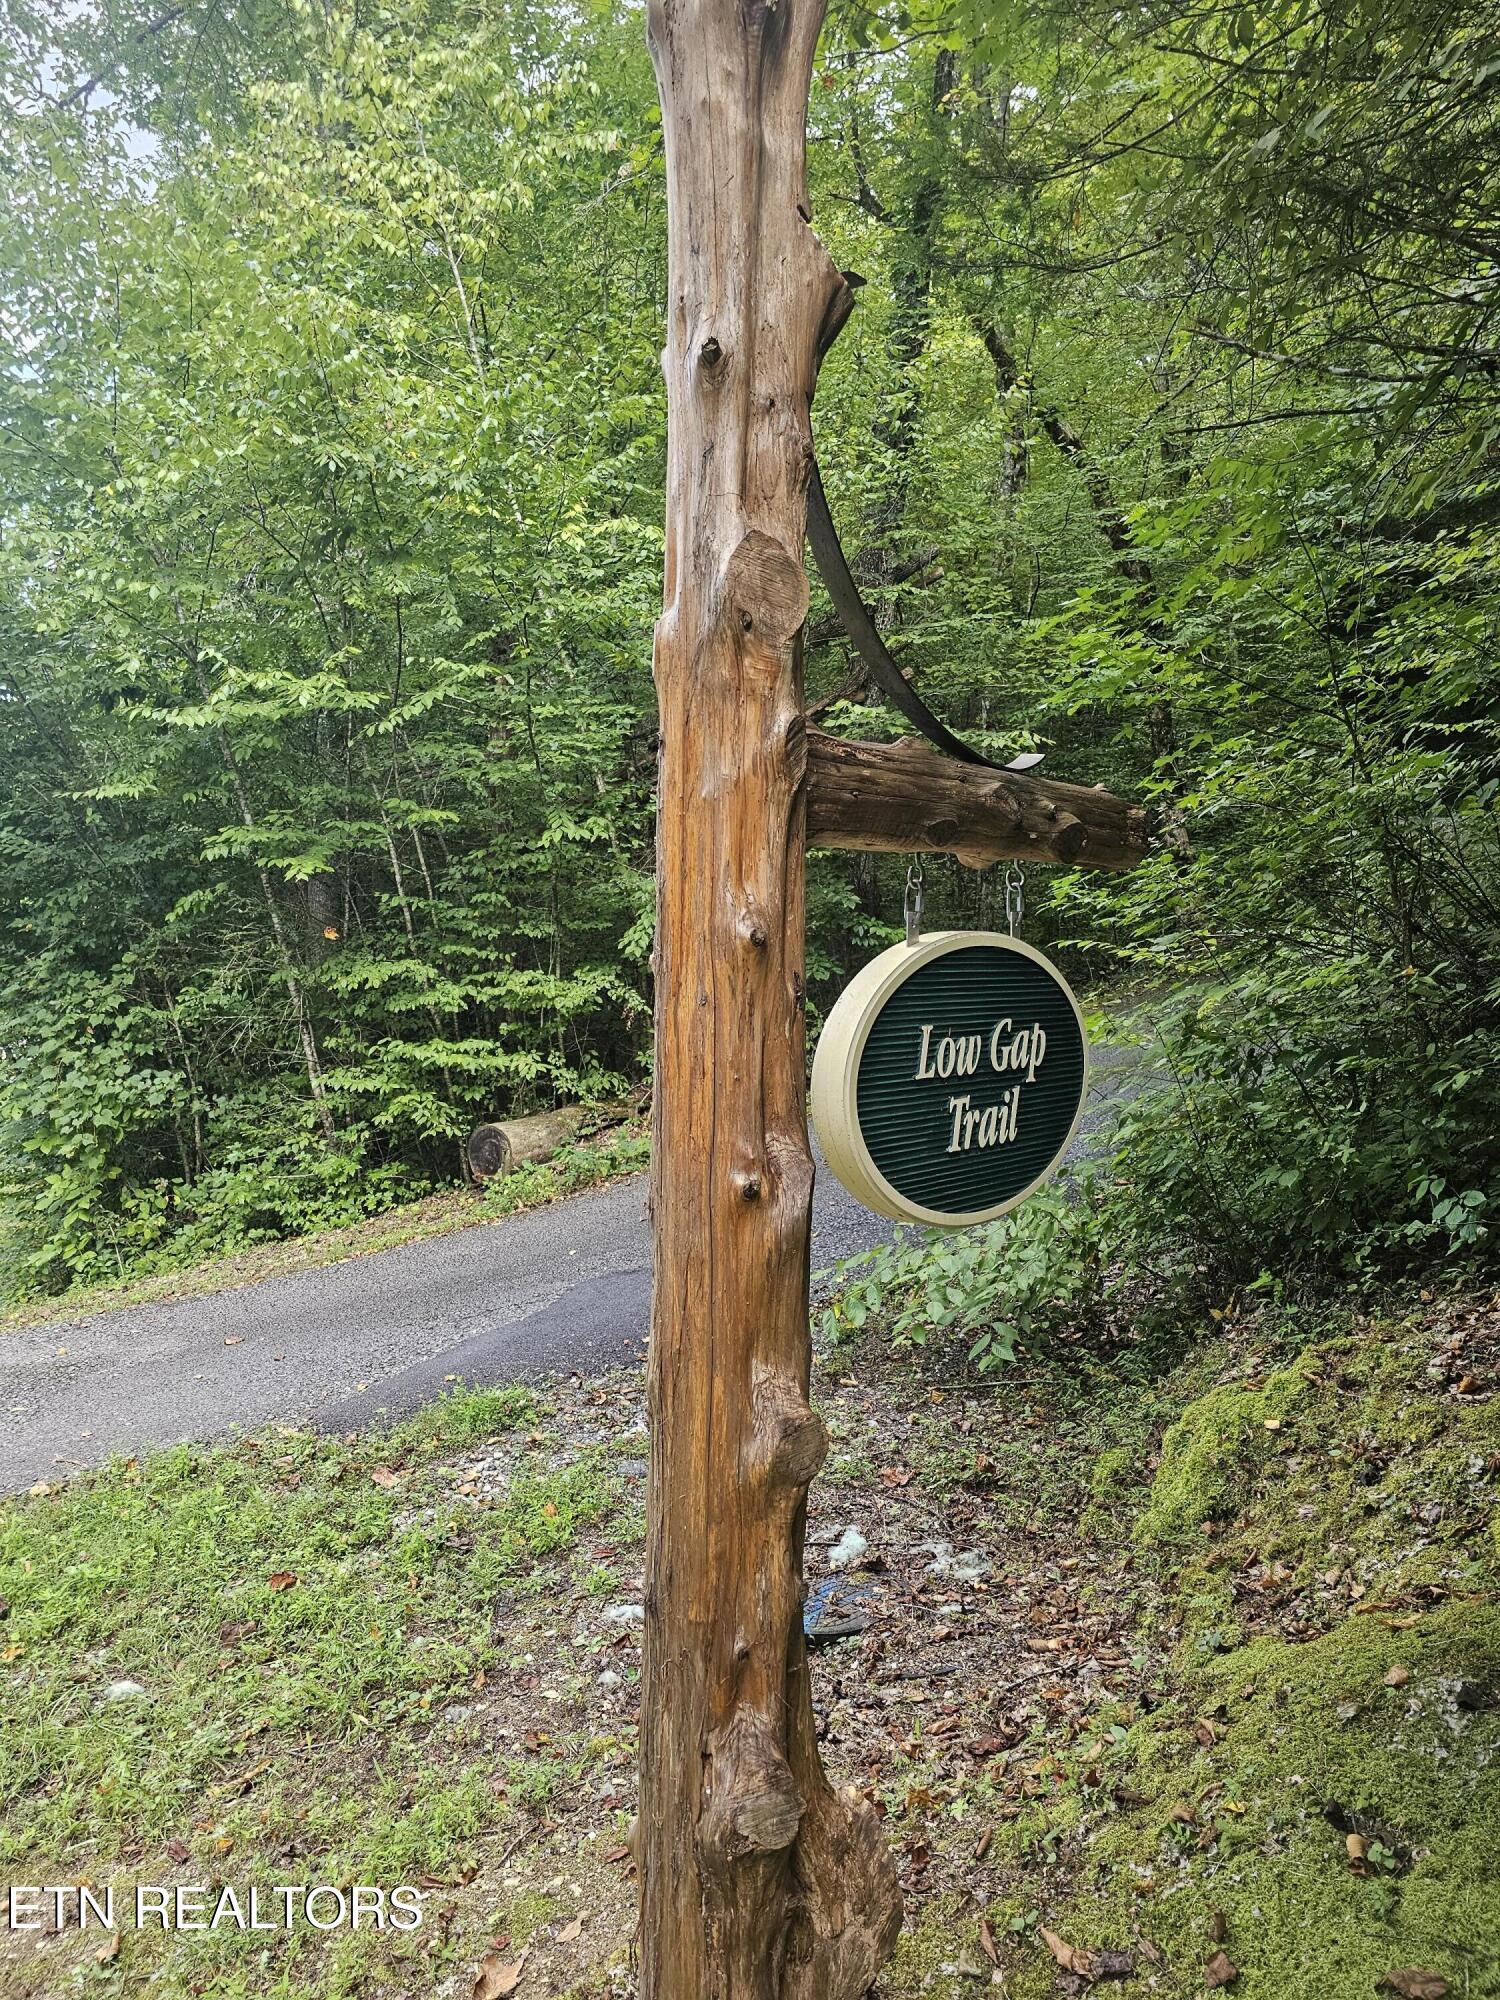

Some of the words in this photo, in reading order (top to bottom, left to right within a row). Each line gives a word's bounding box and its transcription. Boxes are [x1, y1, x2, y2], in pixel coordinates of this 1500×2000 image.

[913, 1024, 982, 1081] Low
[990, 1017, 1047, 1083] Gap
[946, 1085, 1021, 1153] Trail
